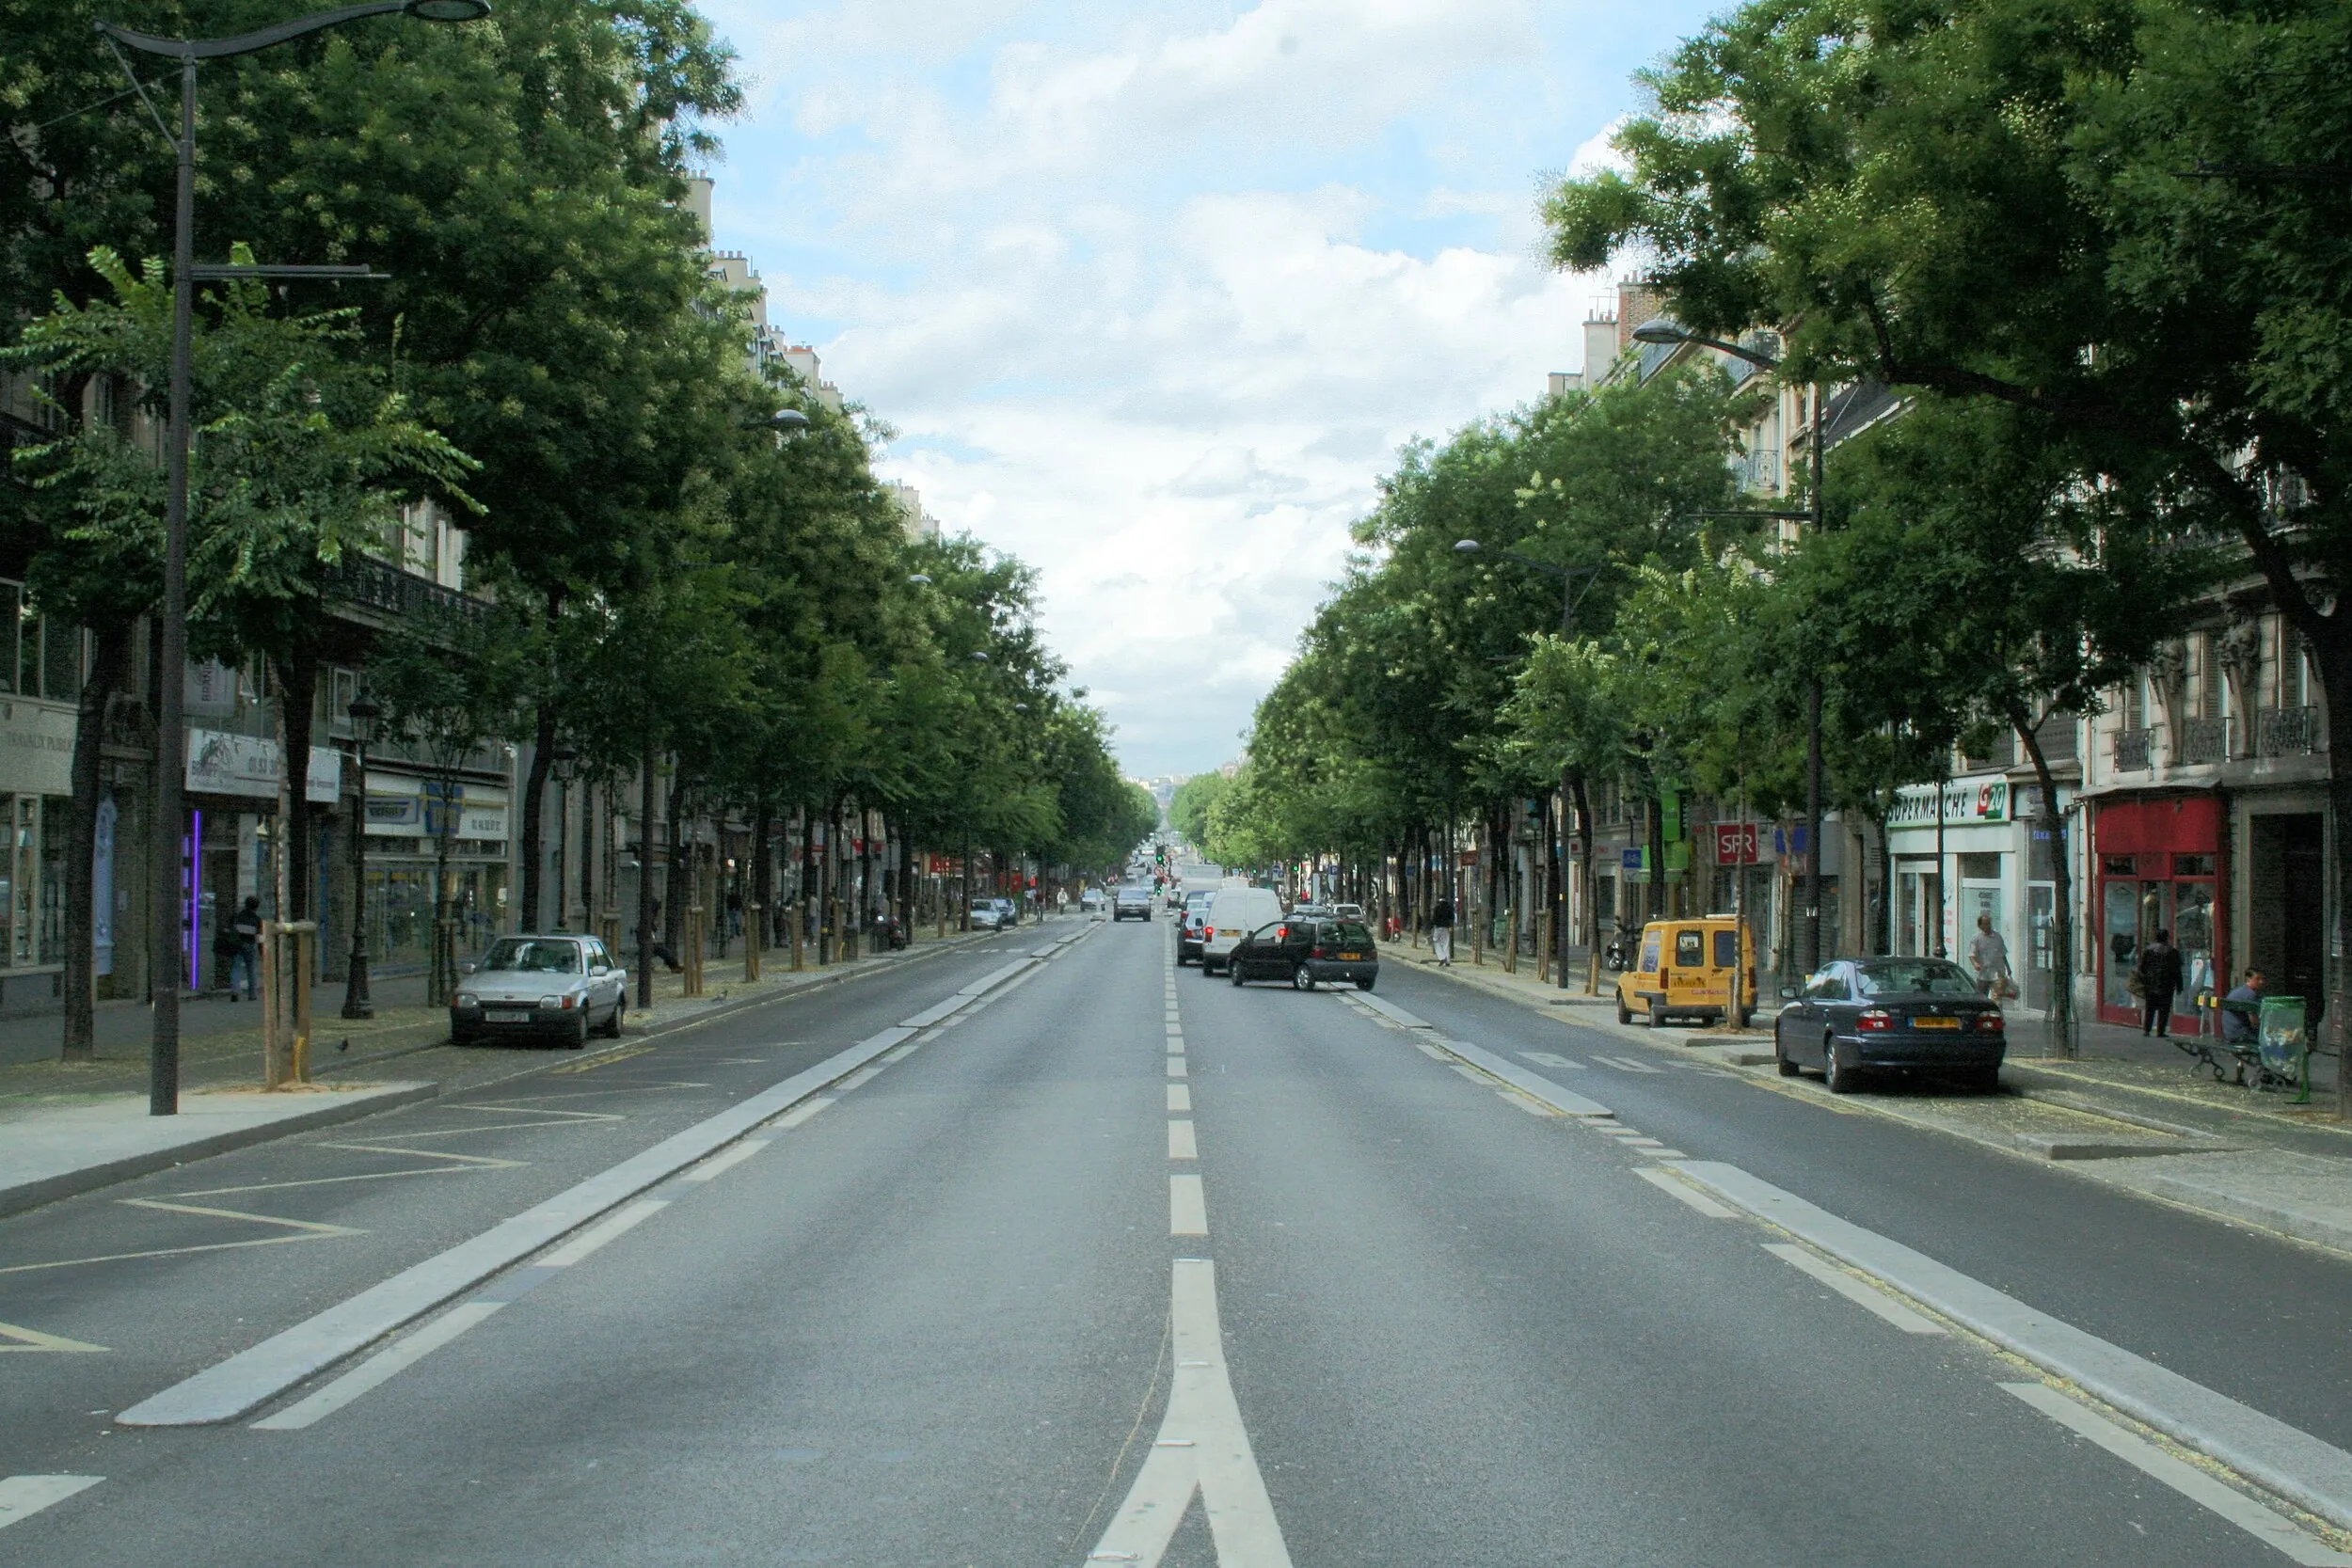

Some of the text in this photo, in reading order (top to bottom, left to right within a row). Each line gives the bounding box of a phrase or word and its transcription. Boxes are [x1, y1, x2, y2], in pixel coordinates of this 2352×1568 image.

[1888, 784, 2004, 821] SUPERMACHÉ G20
[1721, 834, 1754, 854] SFR
